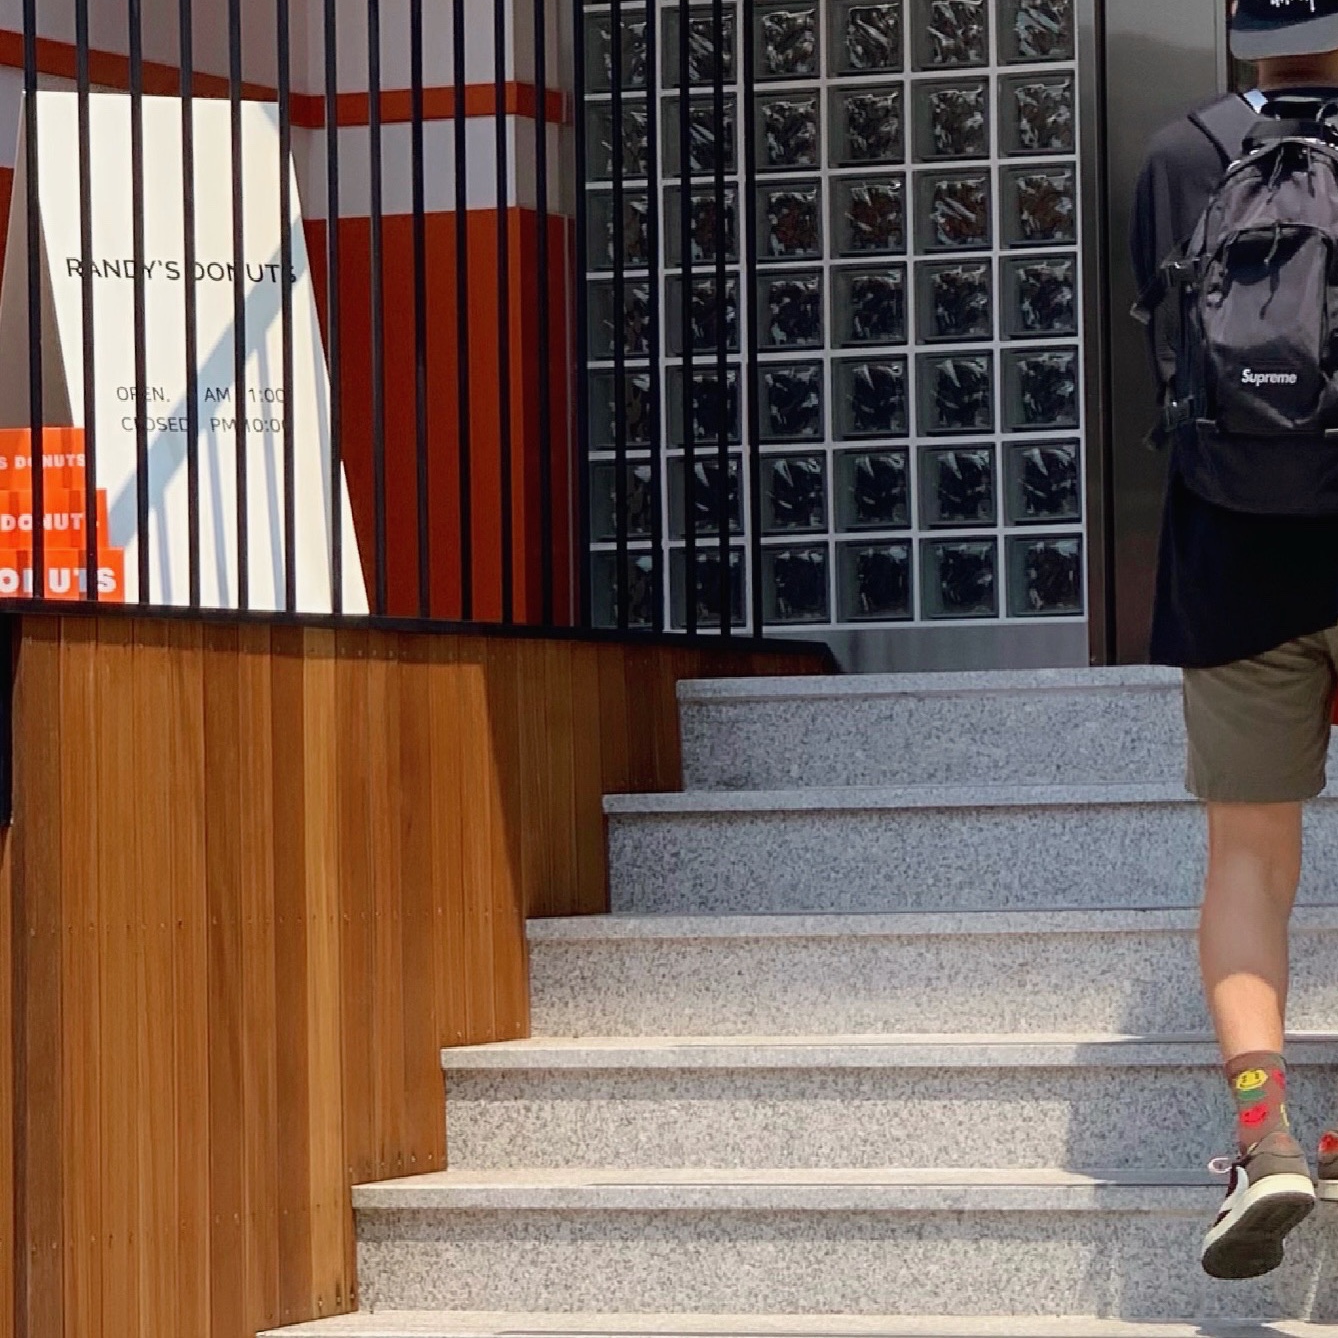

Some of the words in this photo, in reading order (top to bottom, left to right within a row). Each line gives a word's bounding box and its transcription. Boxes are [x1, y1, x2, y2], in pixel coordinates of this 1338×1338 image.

[1241, 368, 1297, 387] Supreme
[204, 387, 231, 403] AM
[211, 417, 237, 433] PM
